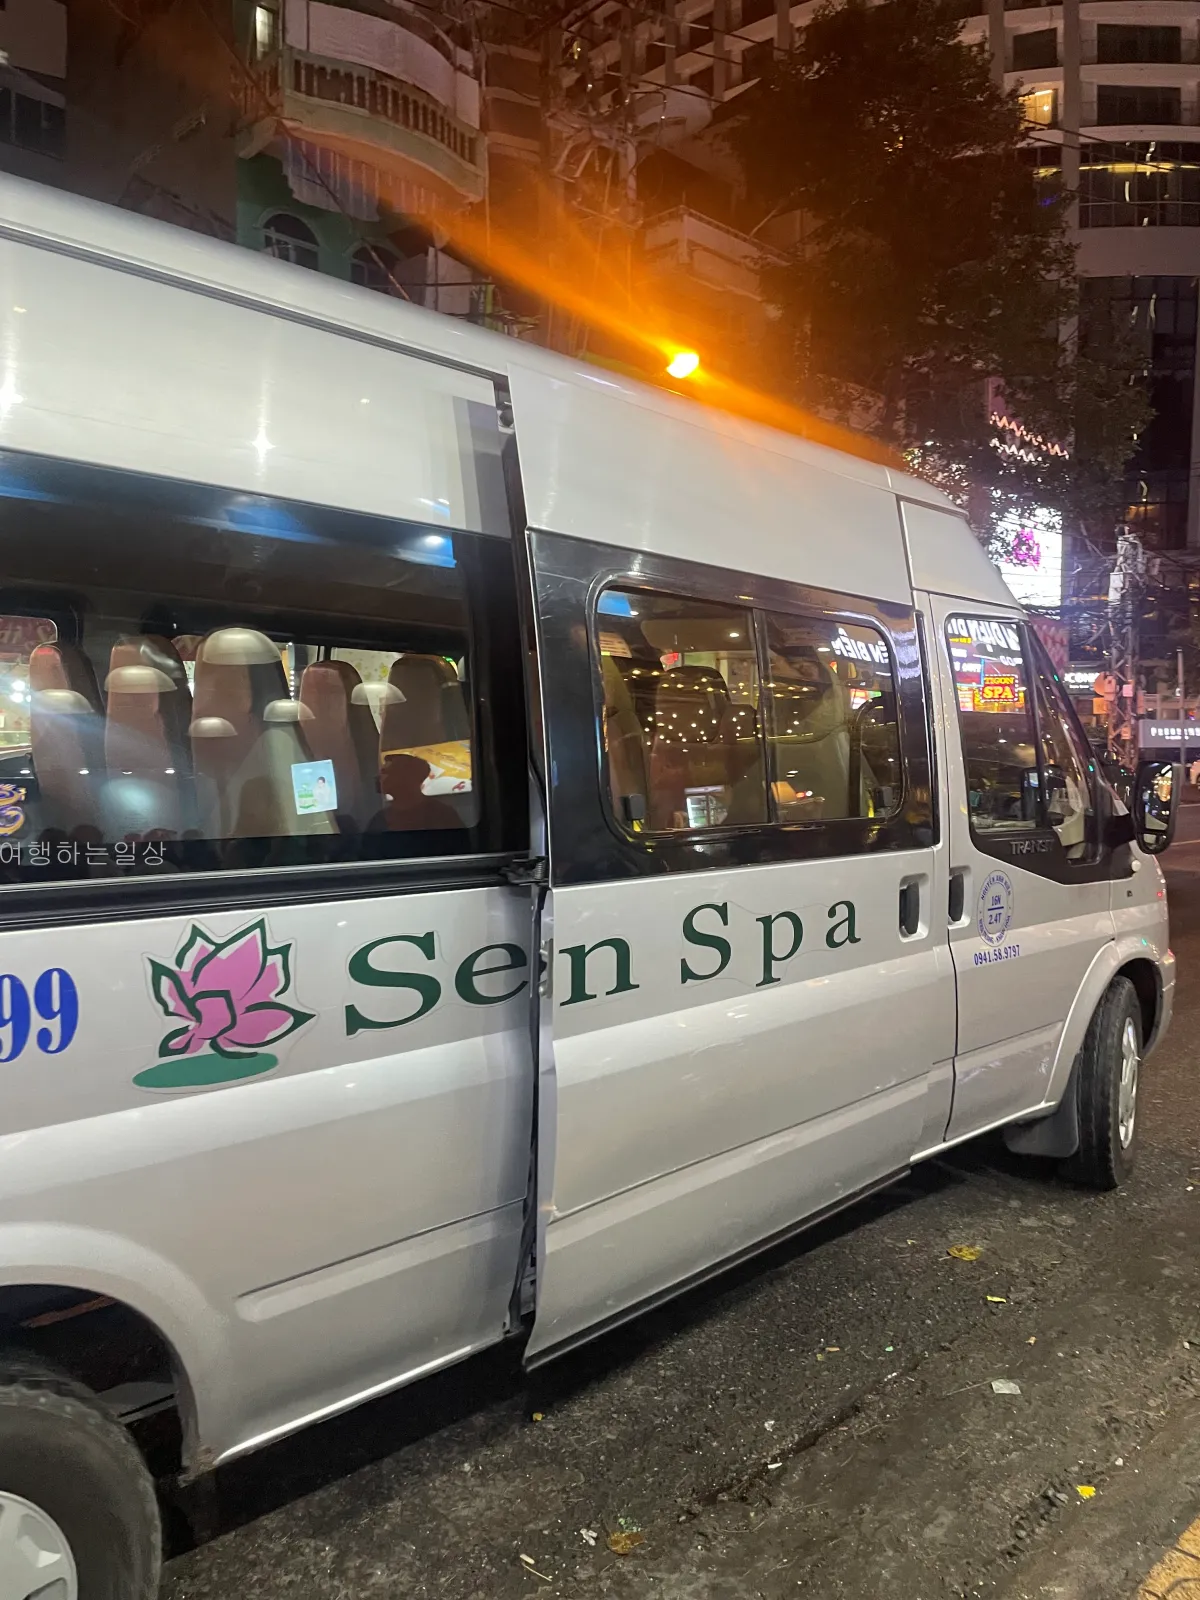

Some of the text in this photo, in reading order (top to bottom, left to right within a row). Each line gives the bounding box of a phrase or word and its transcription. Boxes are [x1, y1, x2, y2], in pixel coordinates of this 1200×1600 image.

[983, 686, 1014, 699] SPA
[344, 899, 862, 1037] Sen Spa
[974, 945, 1021, 966] 0941.58.9797
[0, 967, 77, 1062] 99
